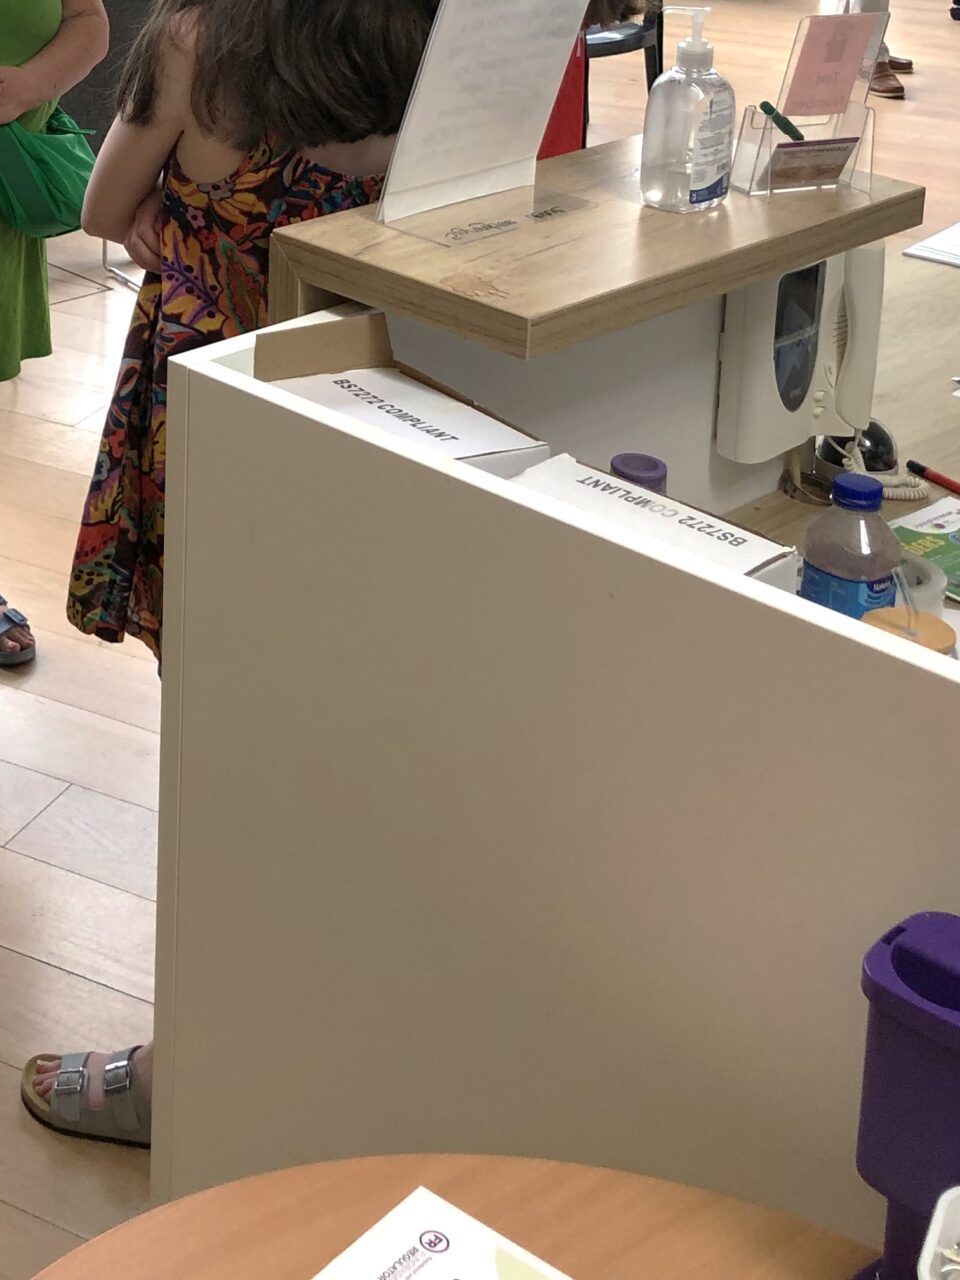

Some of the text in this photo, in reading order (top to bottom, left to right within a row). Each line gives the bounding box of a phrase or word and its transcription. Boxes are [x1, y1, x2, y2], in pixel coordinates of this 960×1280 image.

[332, 379, 459, 442] BS7272 COMPLIANT
[575, 476, 749, 548] BS7272 COMPLIANT
